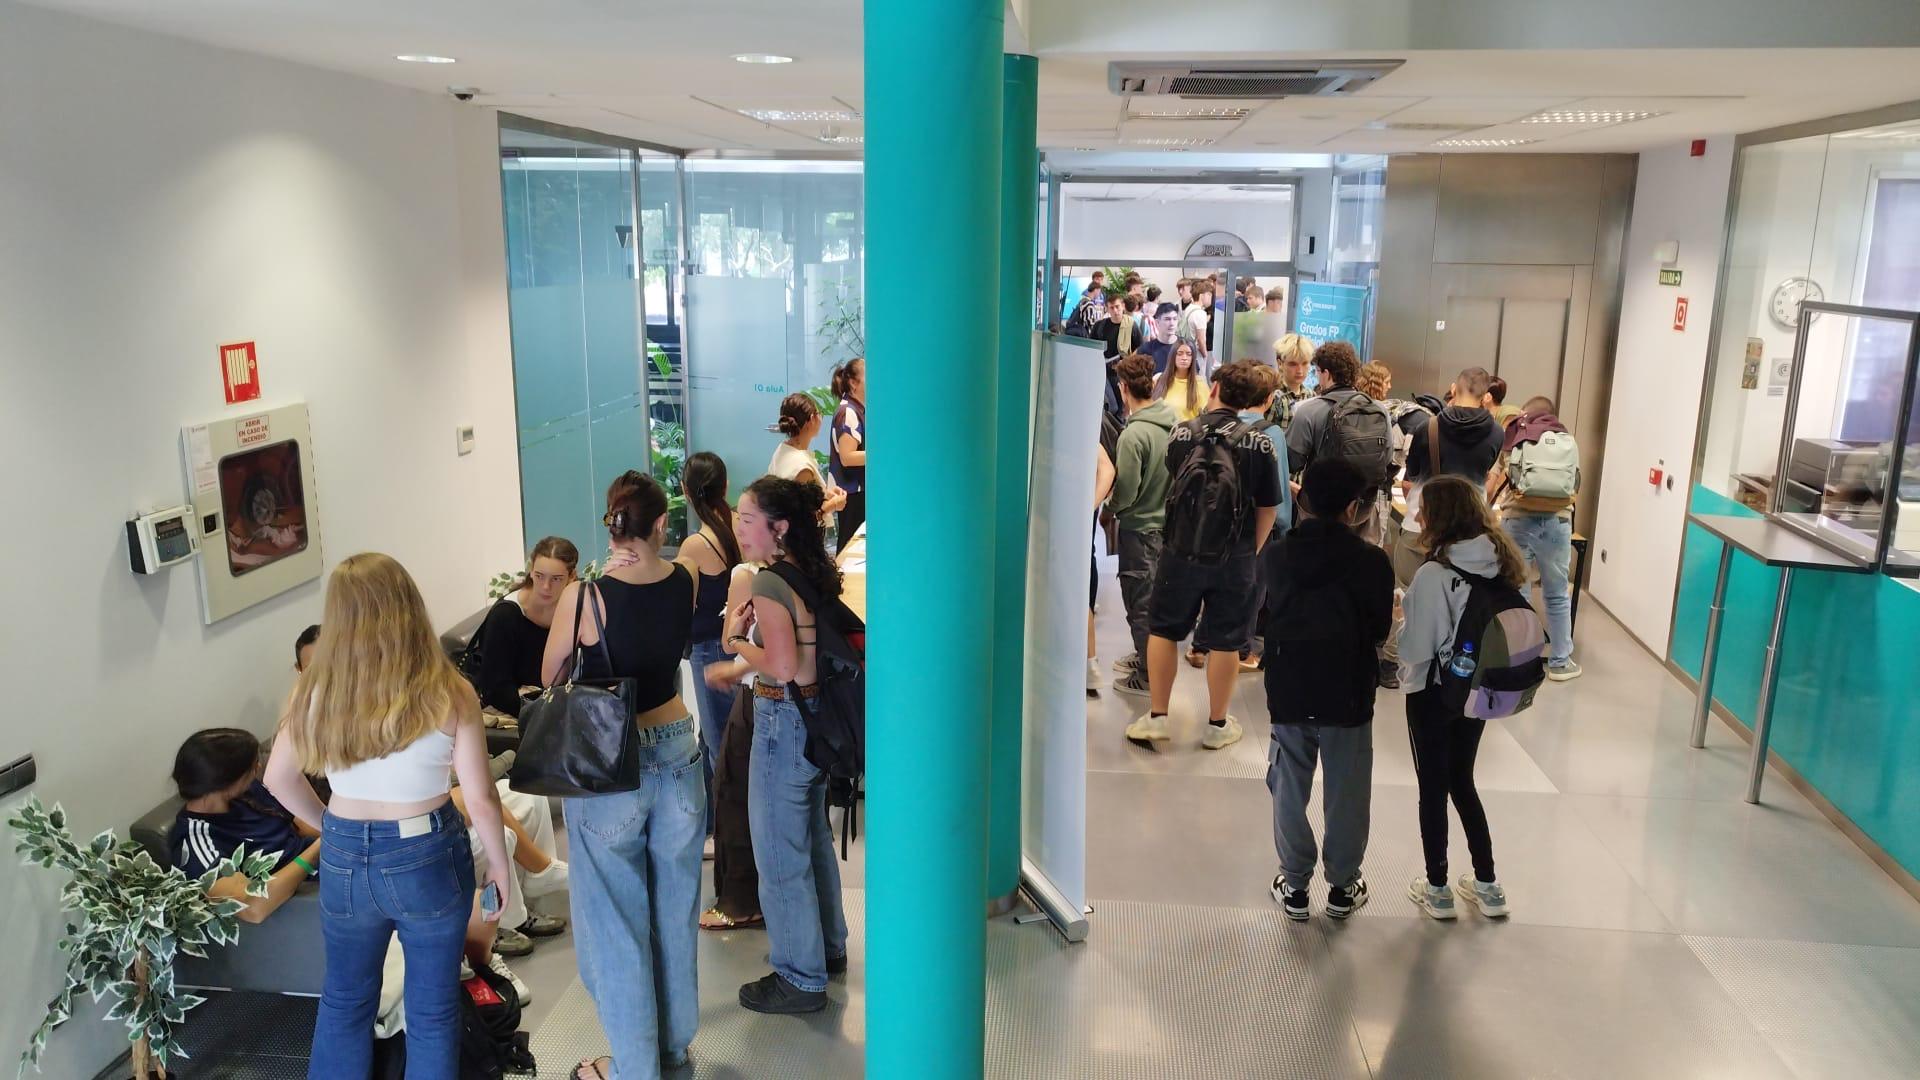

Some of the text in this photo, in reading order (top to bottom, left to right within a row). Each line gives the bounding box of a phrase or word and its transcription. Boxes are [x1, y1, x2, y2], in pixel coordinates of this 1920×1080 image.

[1300, 321, 1340, 338] Grados FP
[245, 419, 261, 427] ABRIR
[246, 427, 261, 435] CASO
[261, 424, 269, 432] DE
[242, 433, 267, 443] INCENDIO
